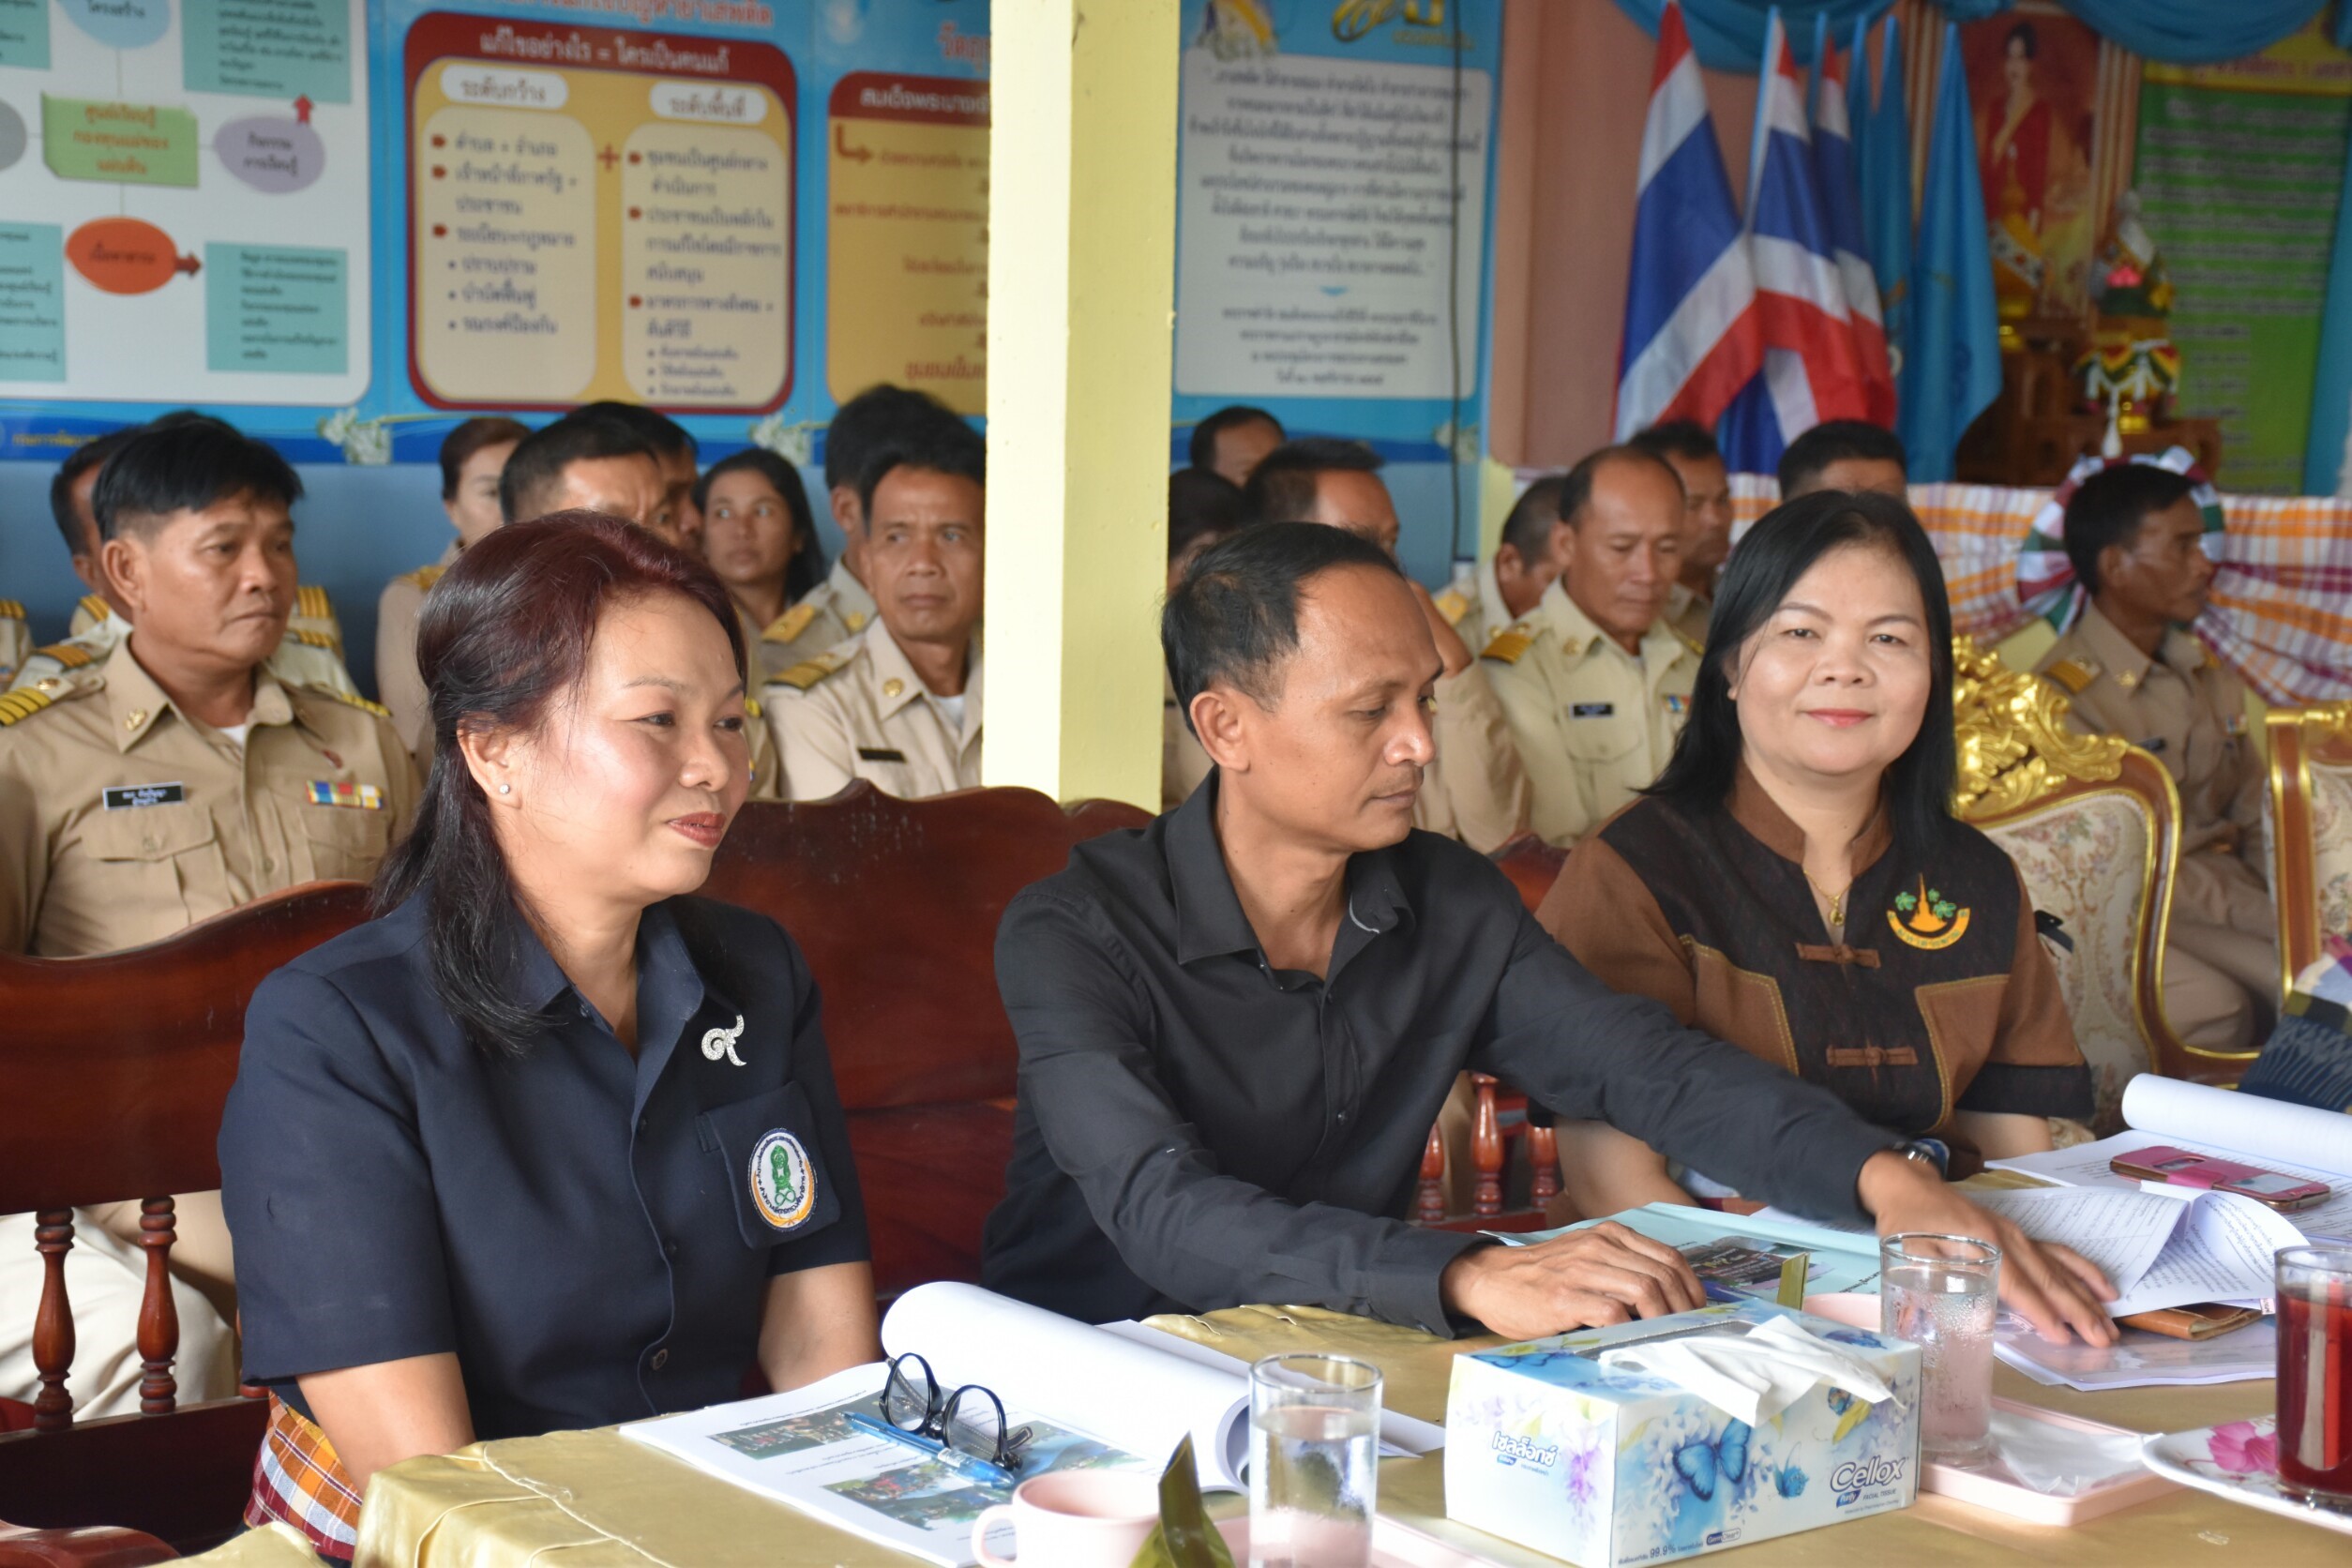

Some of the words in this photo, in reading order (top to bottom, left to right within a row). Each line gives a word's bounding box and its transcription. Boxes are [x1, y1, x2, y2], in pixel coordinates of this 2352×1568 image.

[1830, 1455, 1907, 1493] Cellox
[1862, 1492, 1879, 1501] FACIAL
[1880, 1488, 1897, 1498] TISSUE
[1650, 1544, 1677, 1560] 99.9%
